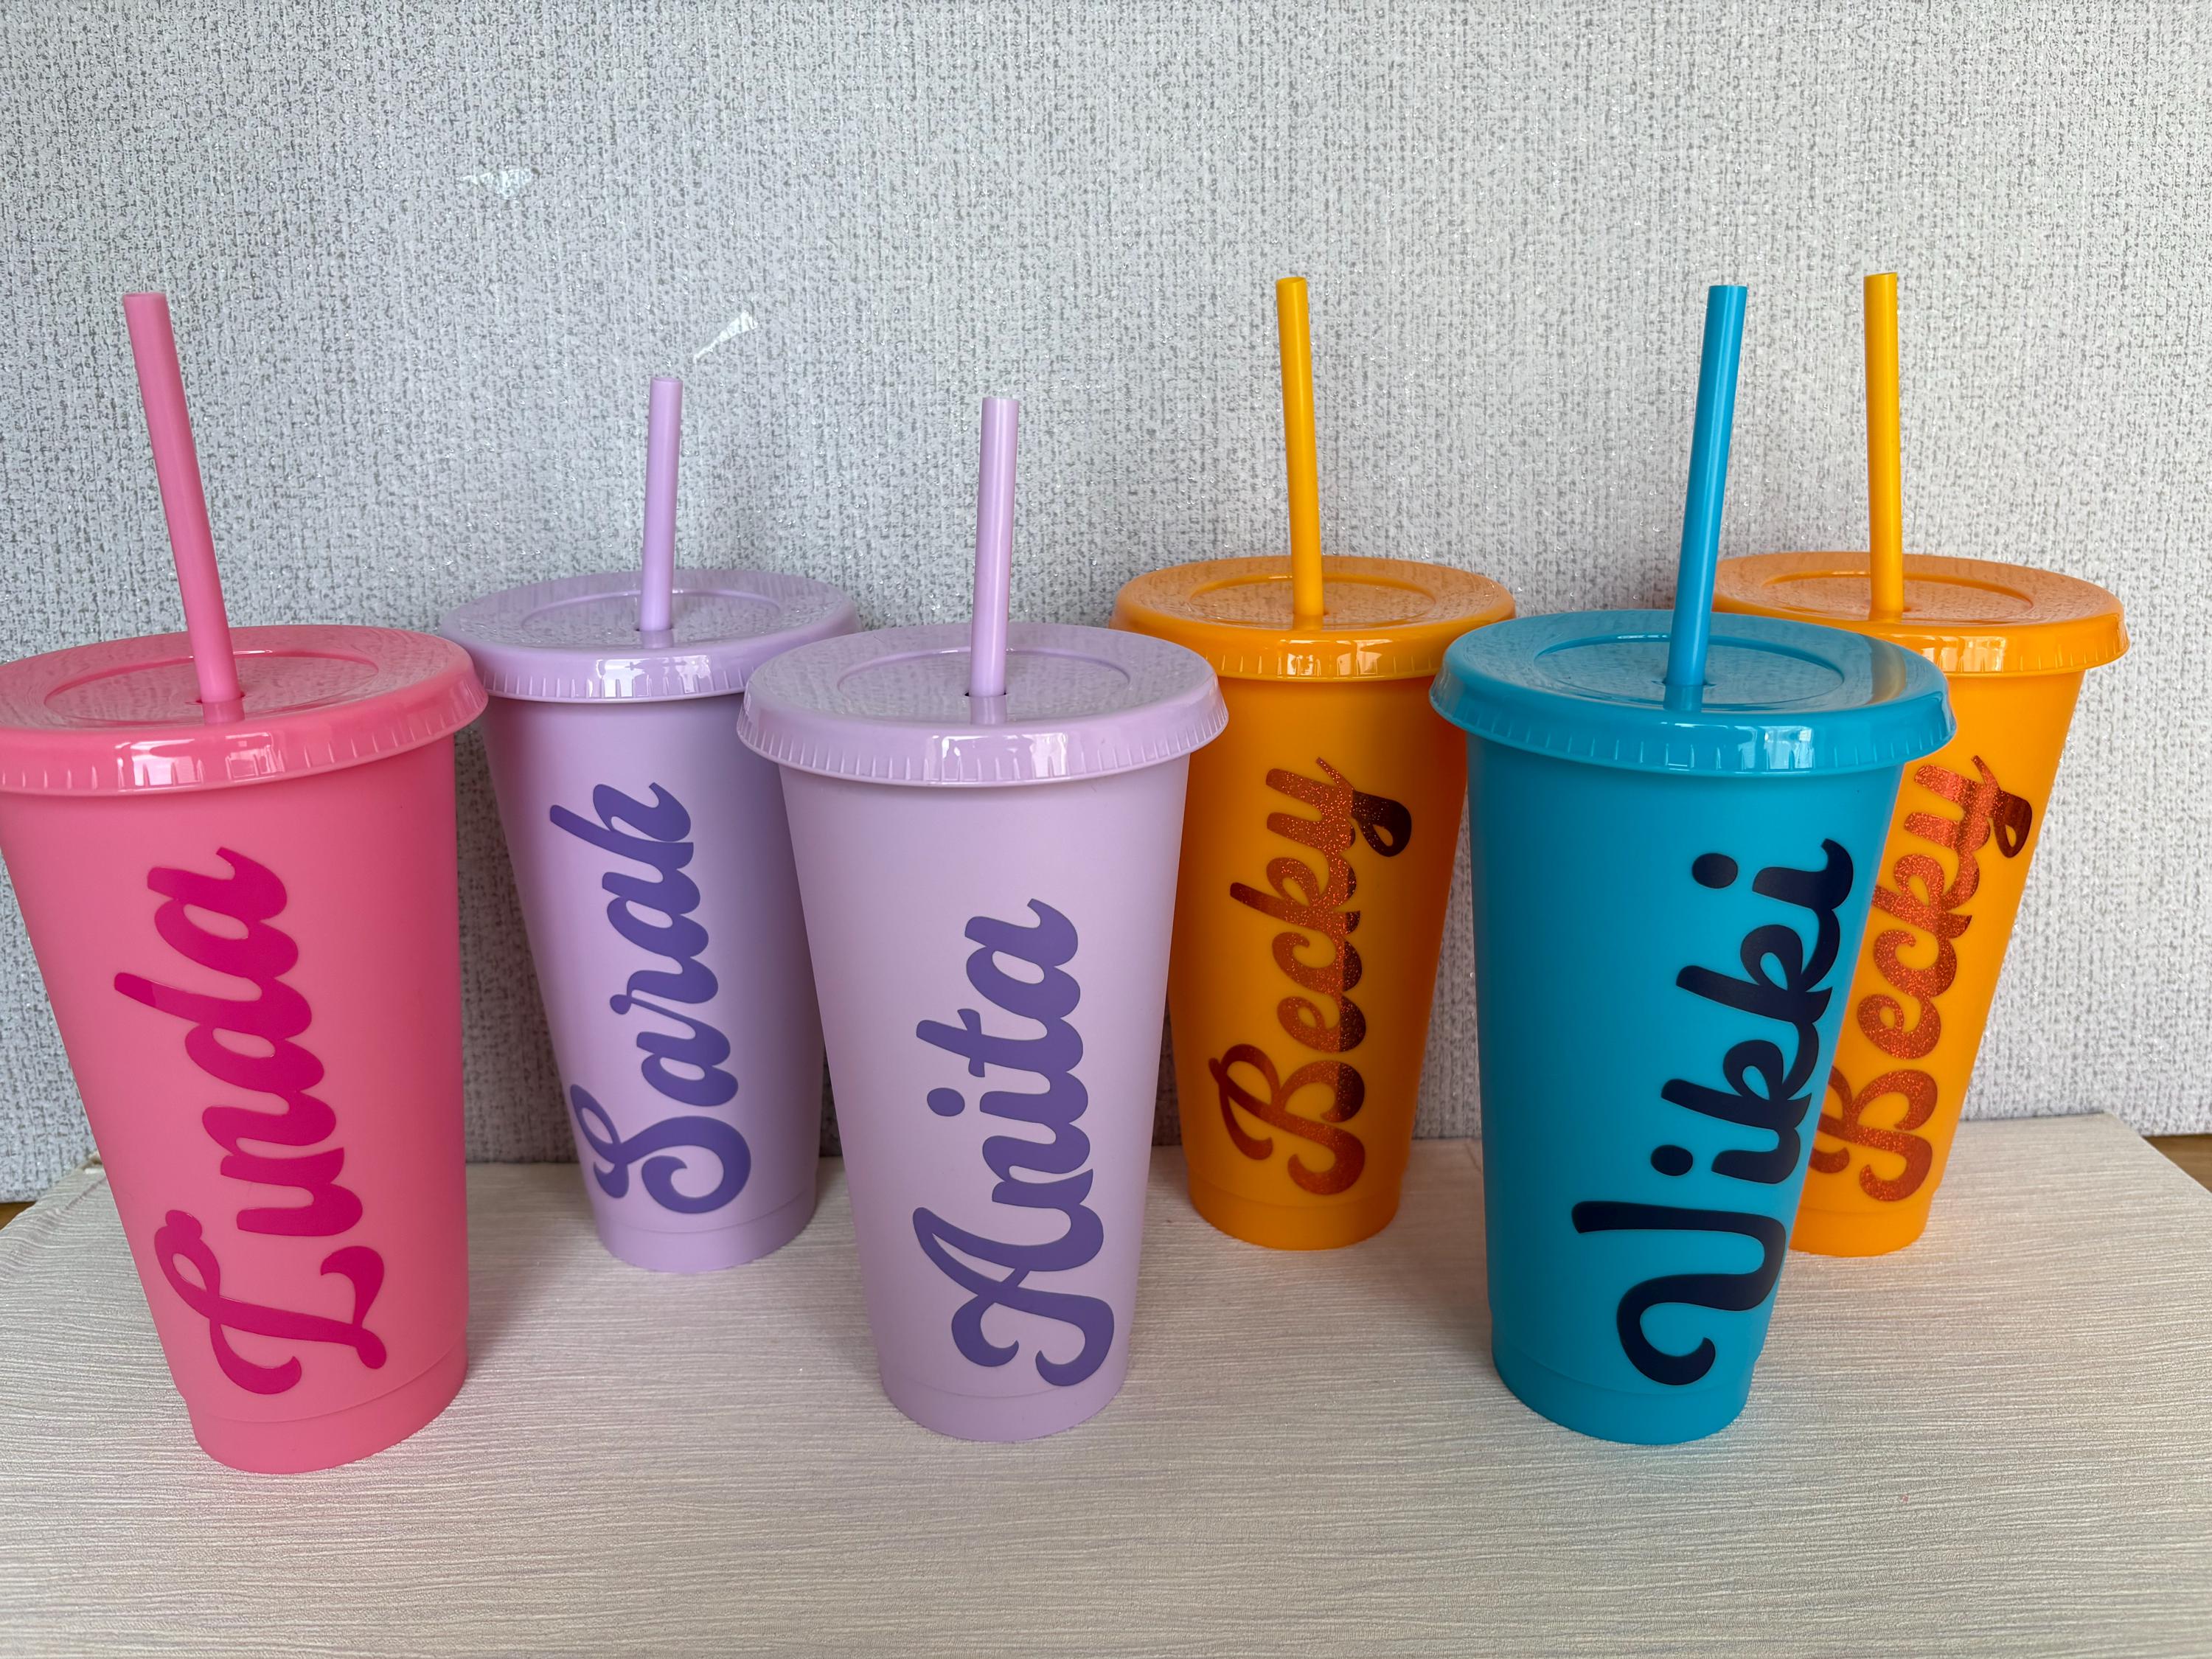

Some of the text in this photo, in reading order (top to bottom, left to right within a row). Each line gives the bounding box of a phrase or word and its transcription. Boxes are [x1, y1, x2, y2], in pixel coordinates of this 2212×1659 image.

[114, 847, 387, 1395] Linda
[550, 782, 751, 1214] Sarah
[913, 898, 1114, 1386] Anita
[1208, 758, 1412, 1195] Becky
[1572, 838, 1854, 1385] Vikki
[1809, 756, 2032, 1202] Becky
